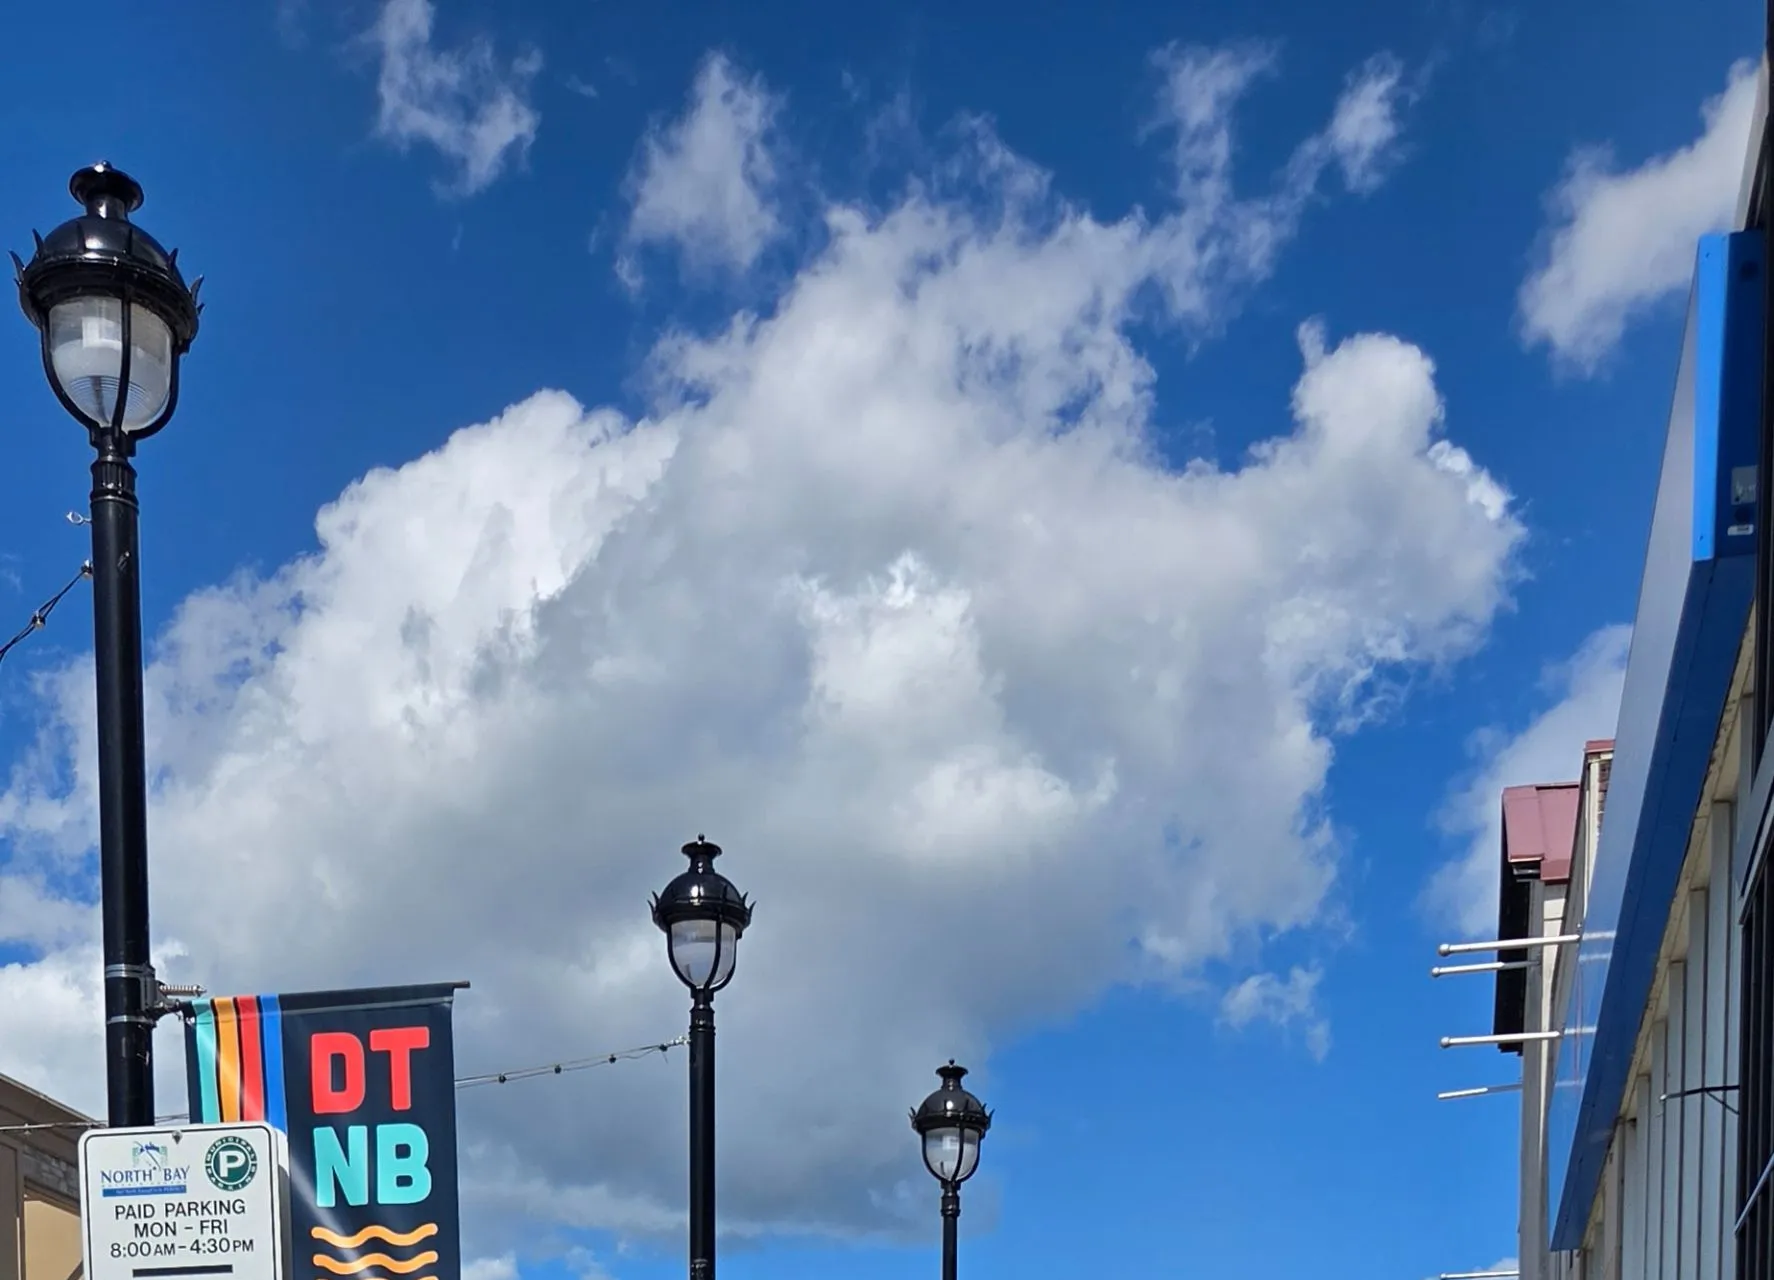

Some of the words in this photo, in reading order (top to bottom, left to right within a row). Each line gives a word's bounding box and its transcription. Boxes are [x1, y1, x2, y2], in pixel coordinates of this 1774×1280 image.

[311, 1026, 430, 1113] DT
[101, 1168, 152, 1183] NORTH
[164, 1165, 190, 1181] BAY
[219, 1150, 246, 1177] P
[313, 1123, 432, 1207] NB
[115, 1203, 155, 1220] PAID
[165, 1199, 245, 1217] PARKING
[134, 1222, 176, 1238] MON
[200, 1219, 228, 1235] FRI
